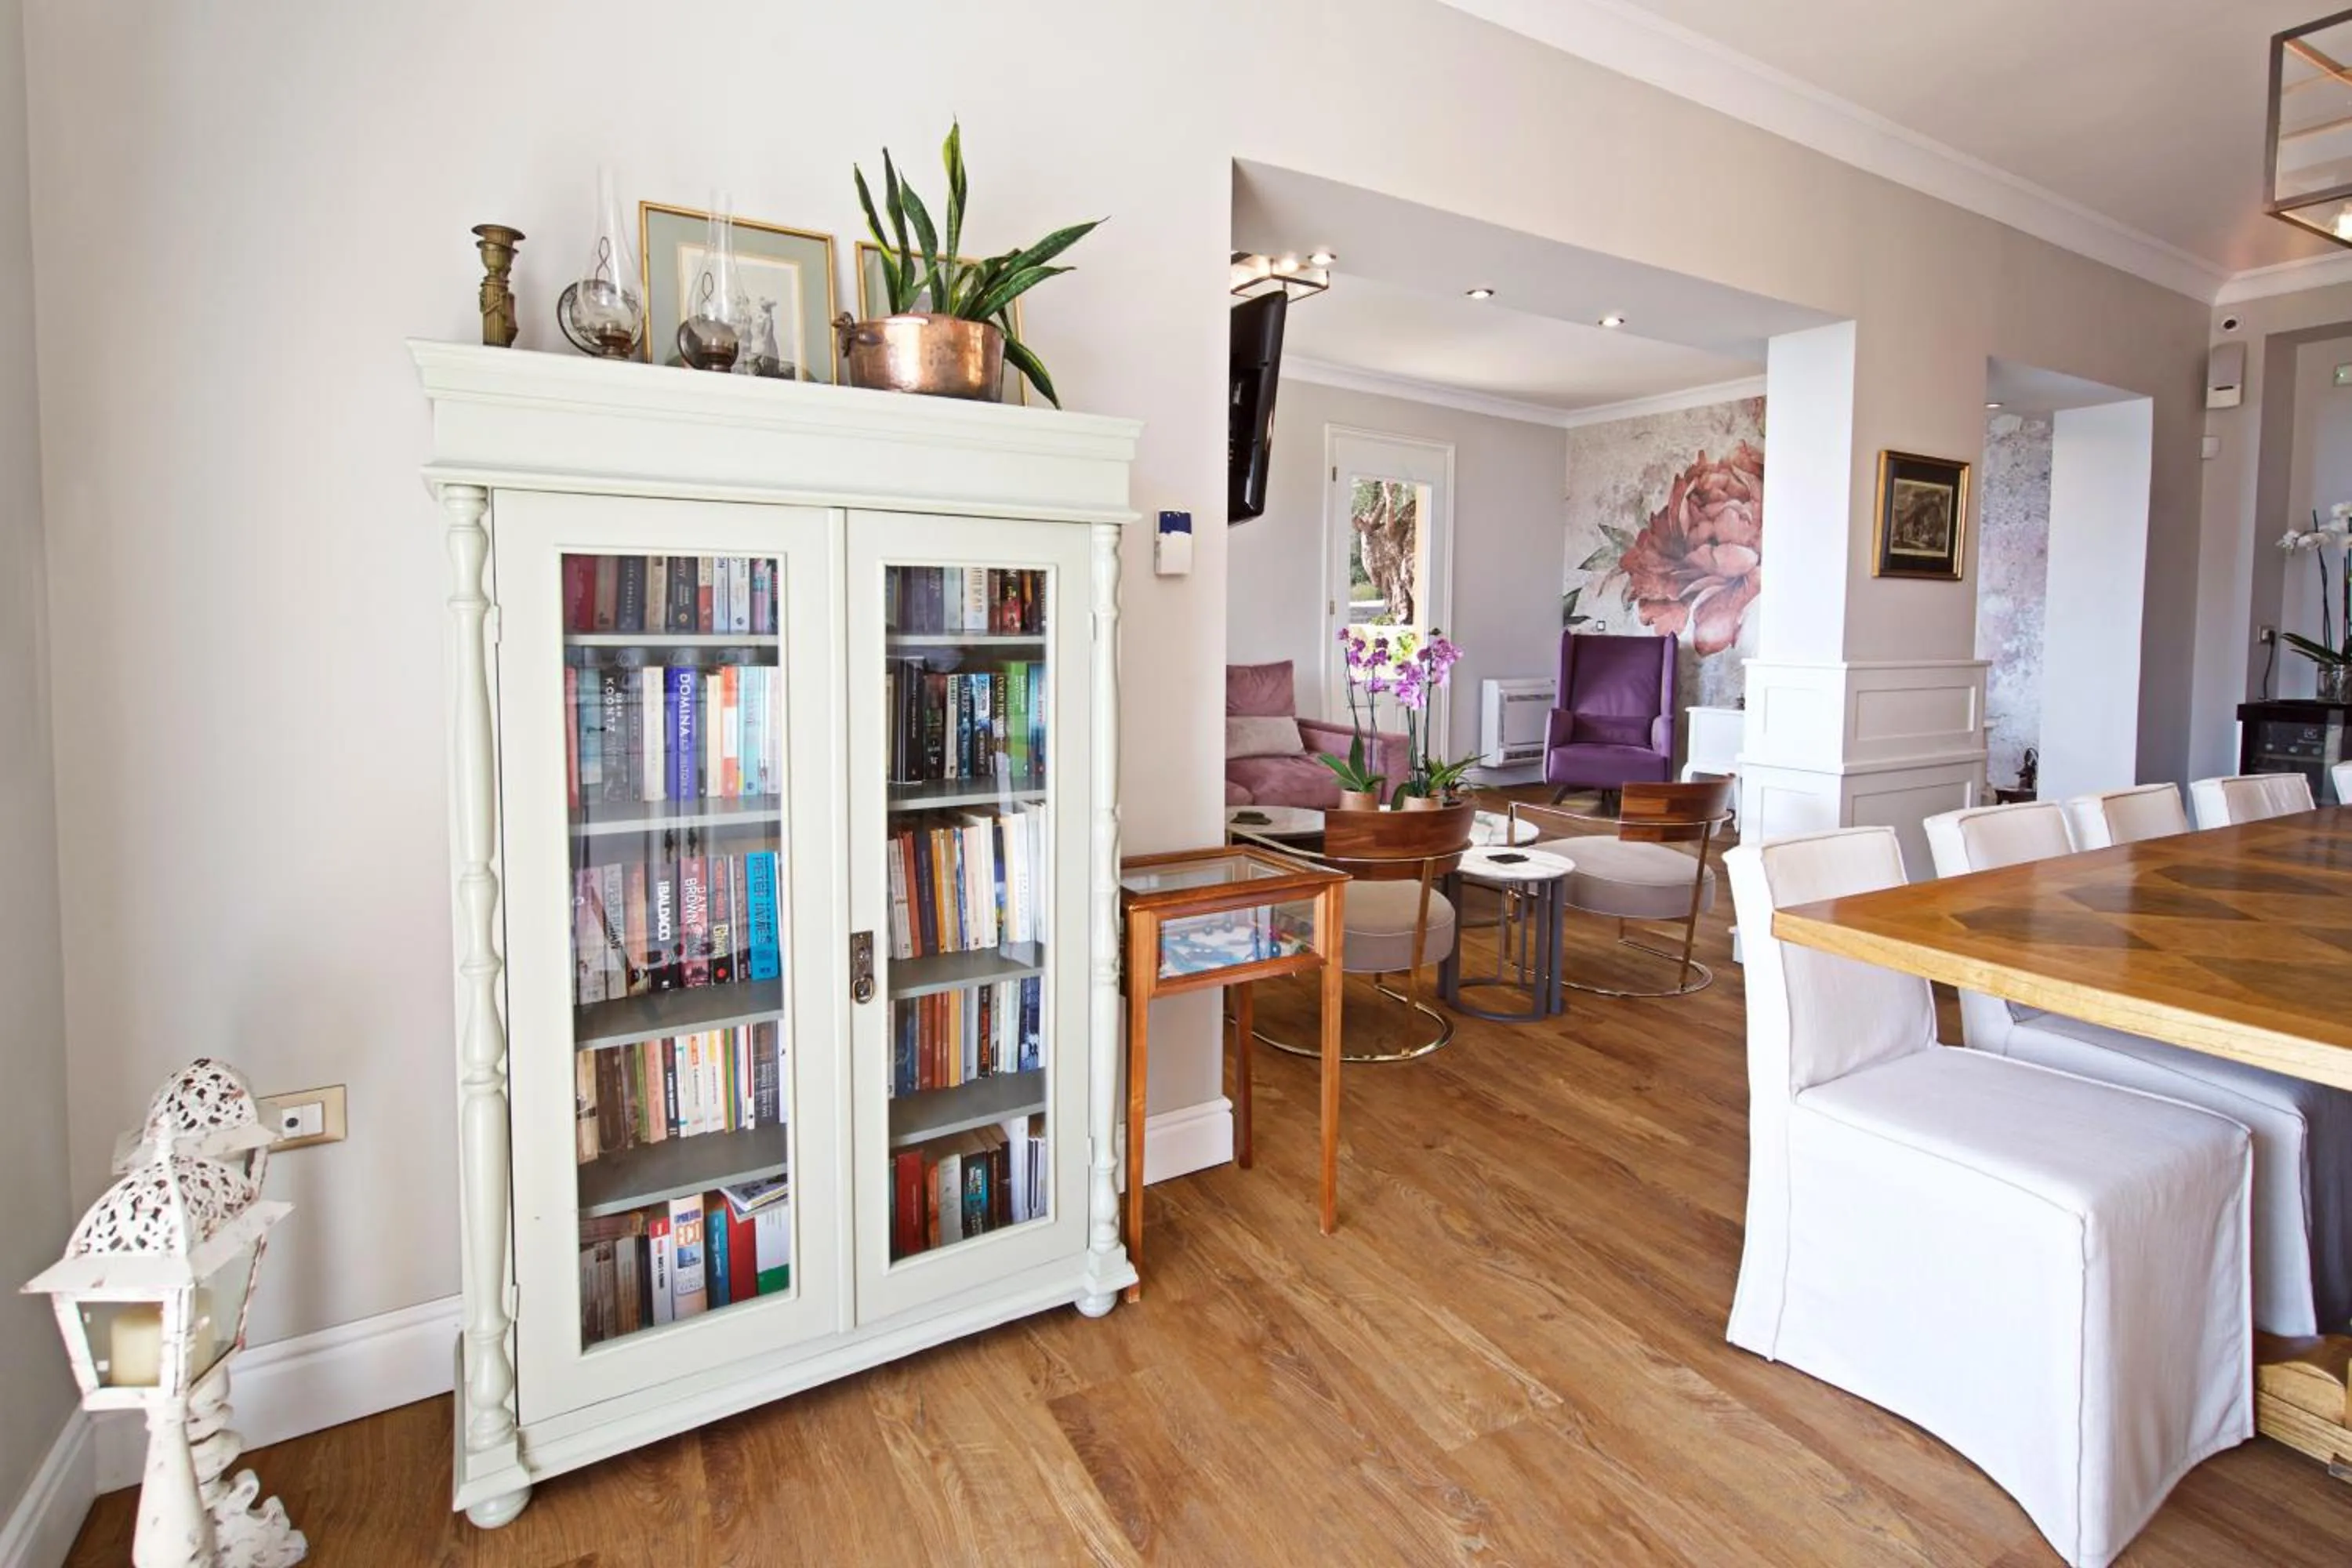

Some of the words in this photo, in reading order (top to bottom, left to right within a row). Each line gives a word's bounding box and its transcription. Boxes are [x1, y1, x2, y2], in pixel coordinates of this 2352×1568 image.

[604, 677, 615, 732] KOONTZ
[679, 673, 691, 737] DOMINA
[685, 878, 697, 924] BROWN
[697, 885, 706, 912] DAN
